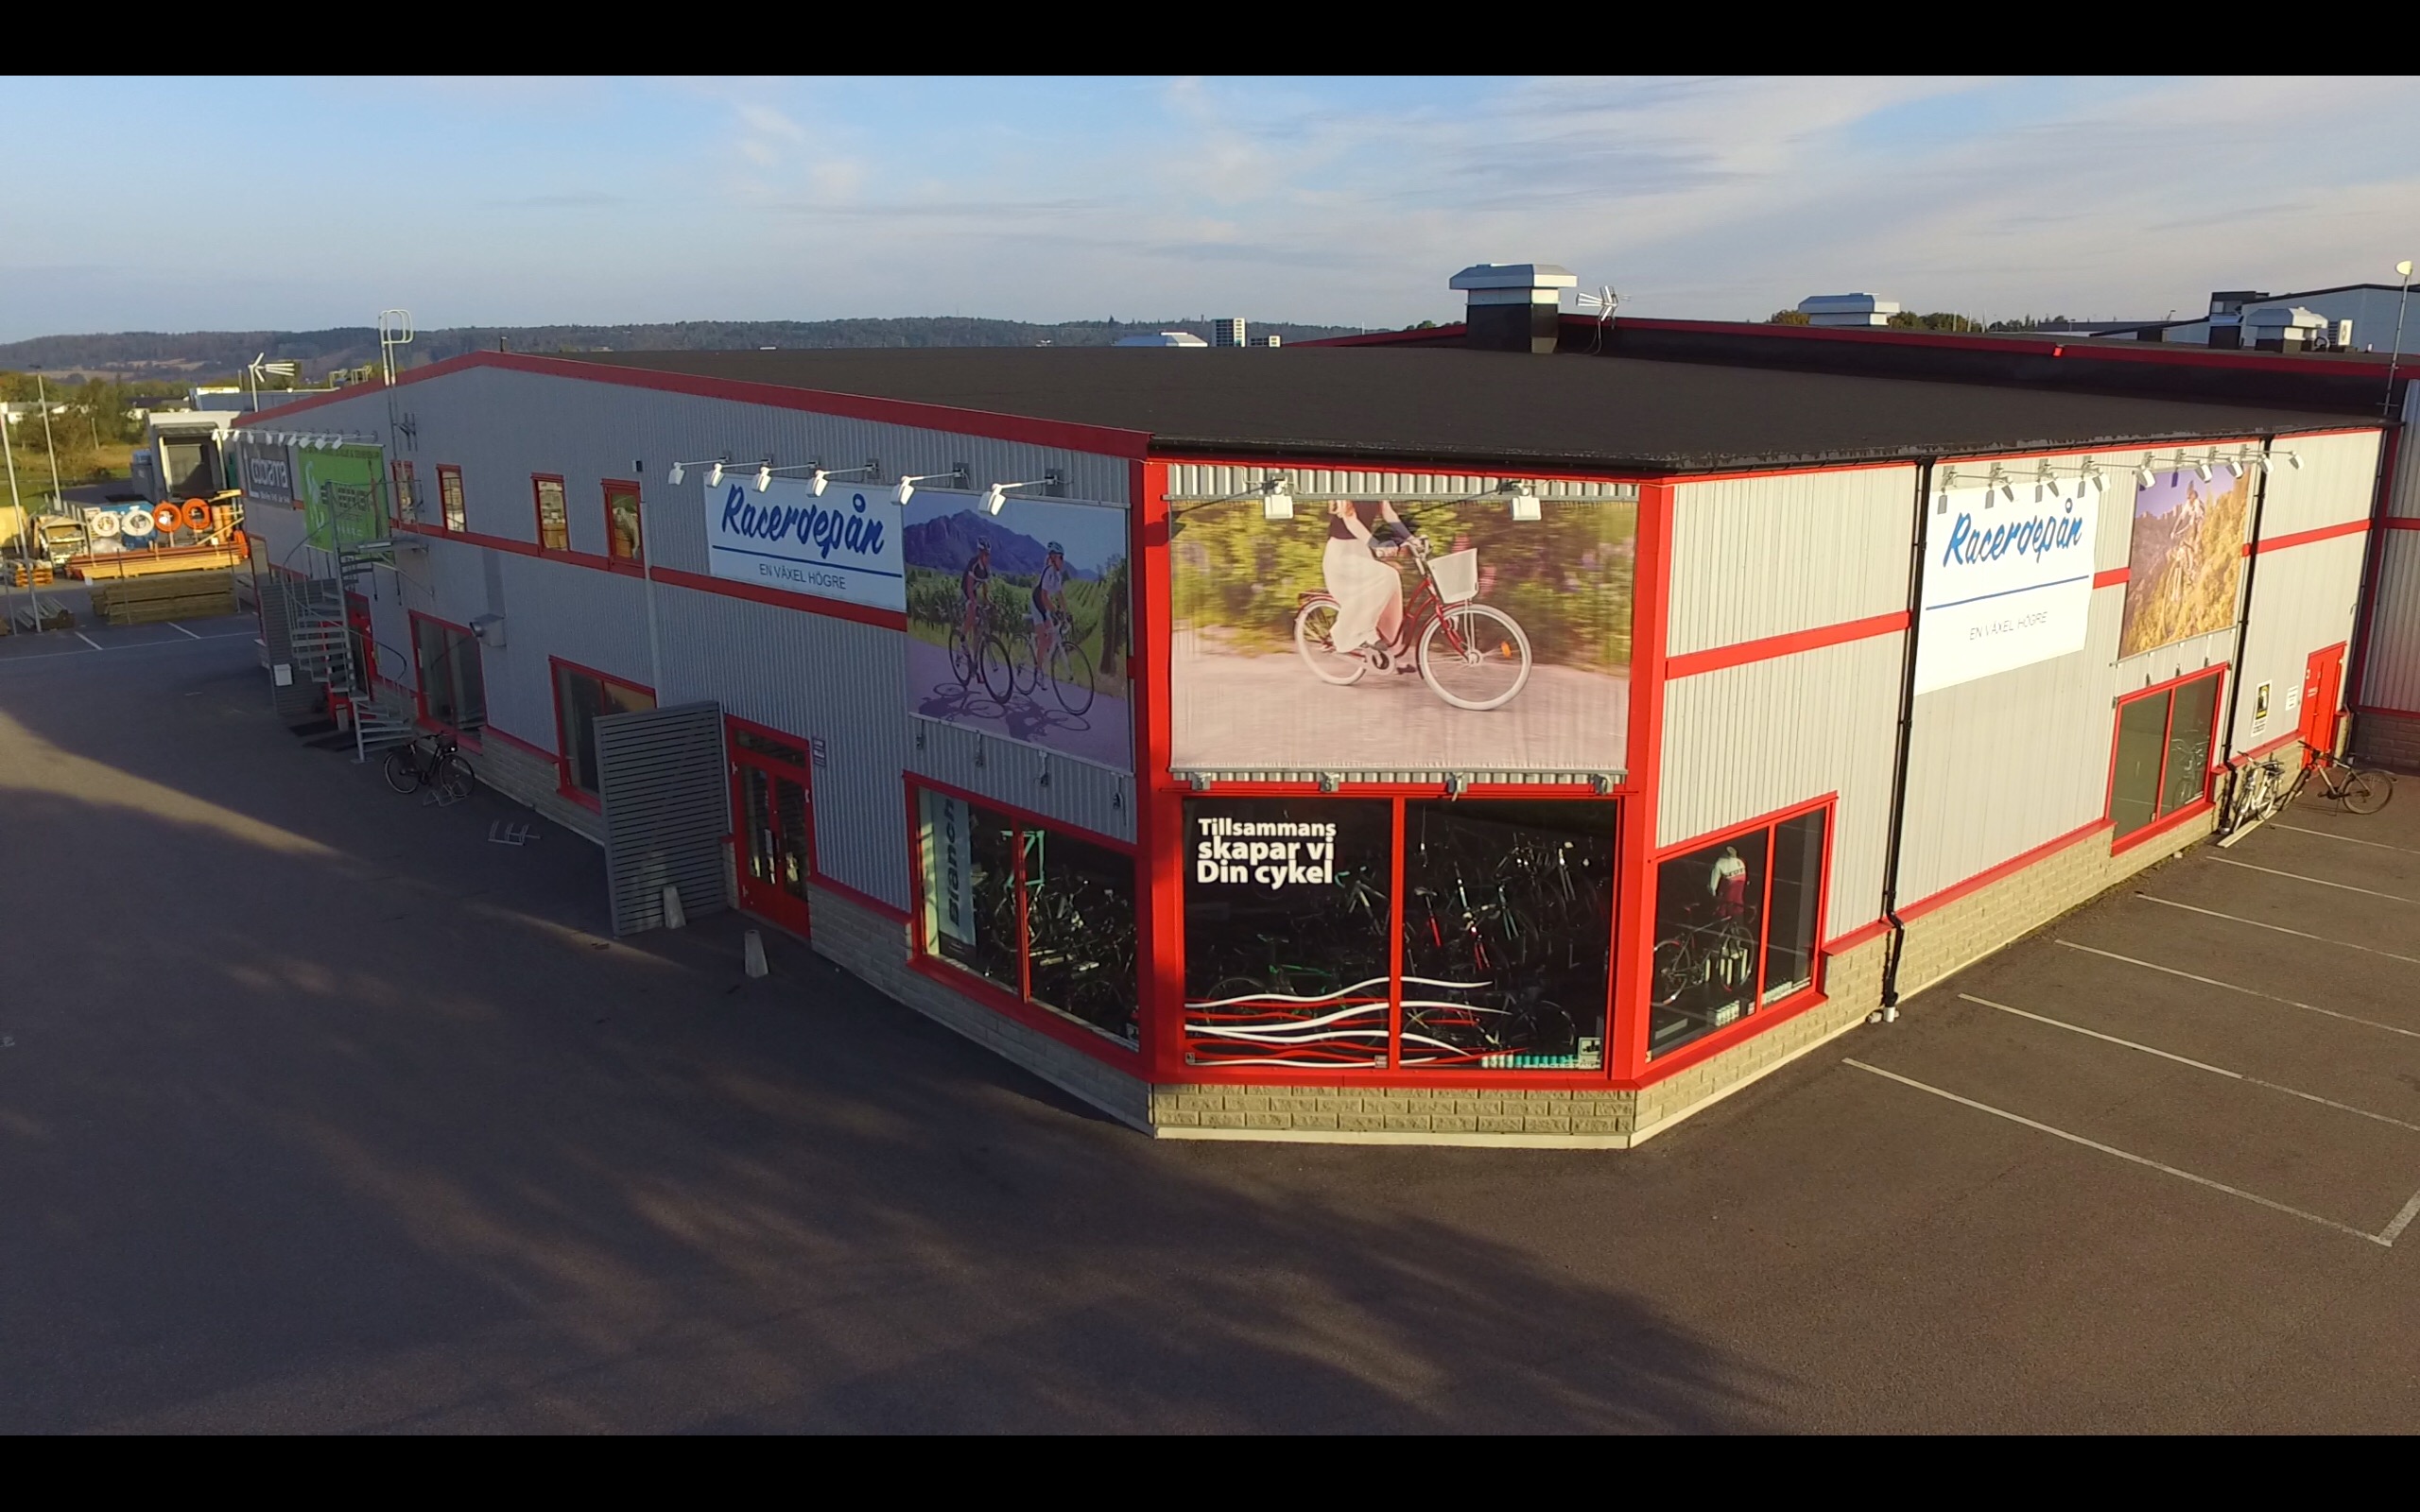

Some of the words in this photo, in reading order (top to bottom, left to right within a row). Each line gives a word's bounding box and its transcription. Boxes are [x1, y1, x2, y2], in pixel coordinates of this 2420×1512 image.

[721, 484, 885, 559] Racerdepån
[1943, 497, 2083, 568] Racerdepån
[759, 563, 773, 576] EN
[774, 566, 806, 583] VÄXEL
[808, 572, 846, 590] HÖGRE
[1969, 626, 1983, 641] EN
[1198, 817, 1337, 836] Tillsammans
[944, 798, 959, 927] Bianch
[1198, 835, 1301, 866] skapar
[1306, 836, 1334, 860] vi
[1197, 859, 1249, 884] Din
[1254, 859, 1333, 890] cykel
